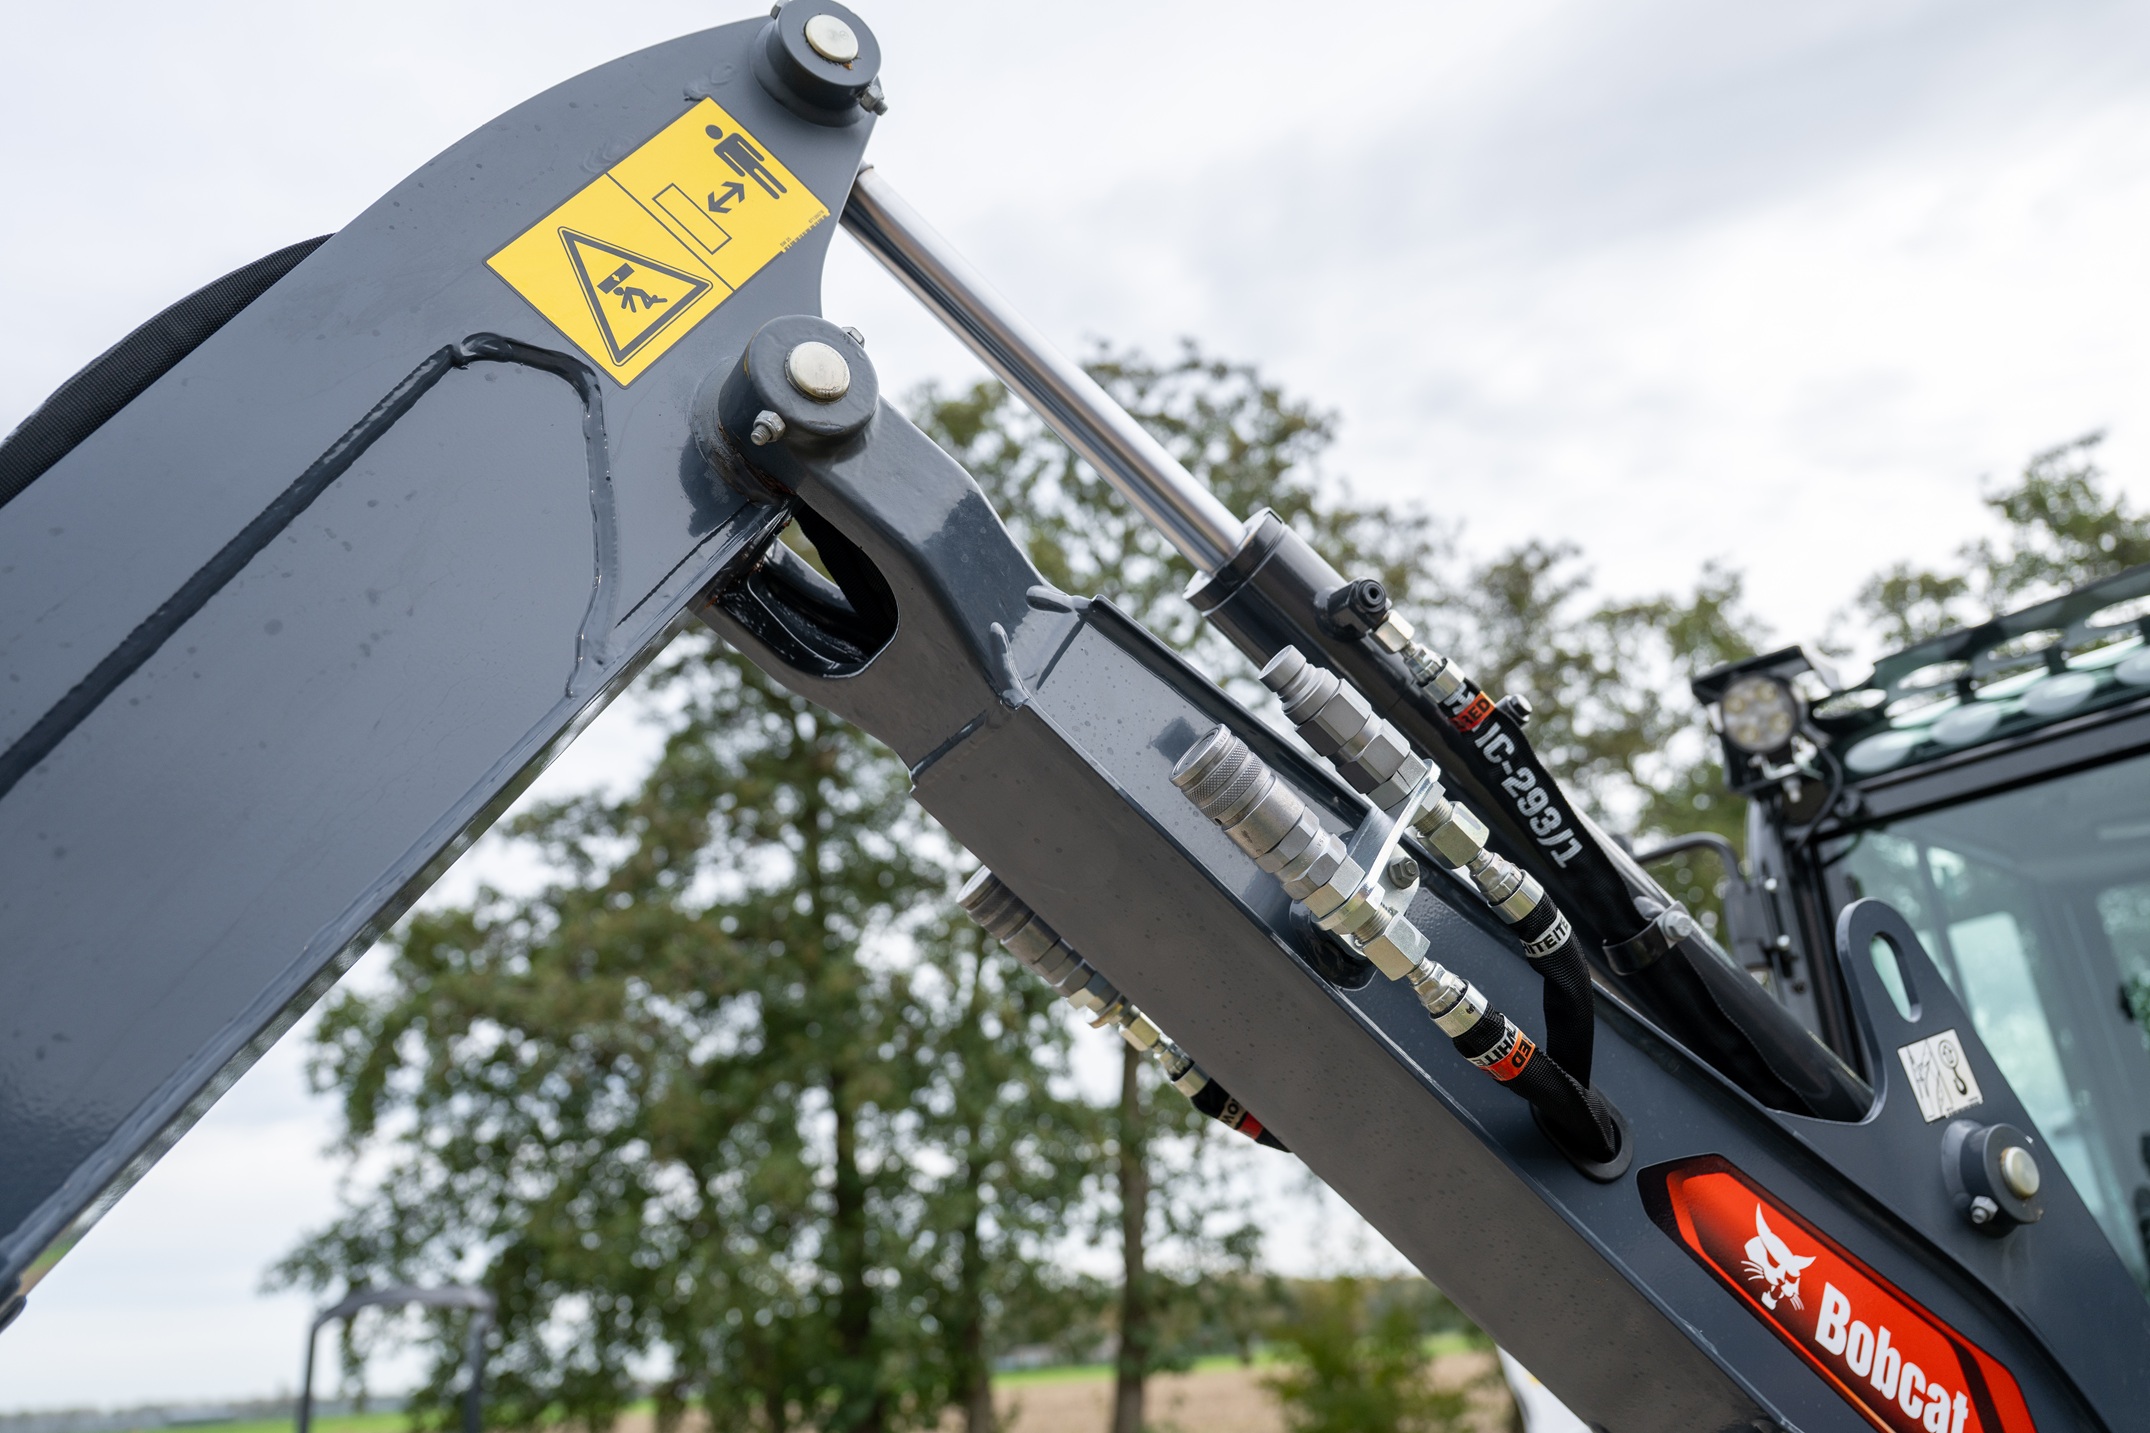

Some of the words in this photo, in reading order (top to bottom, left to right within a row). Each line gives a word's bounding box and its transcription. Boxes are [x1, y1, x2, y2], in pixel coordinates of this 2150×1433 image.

[1474, 722, 1583, 868] IC-293/1
[1511, 1039, 1532, 1068] ED
[1814, 1281, 1969, 1433] Bobcat
